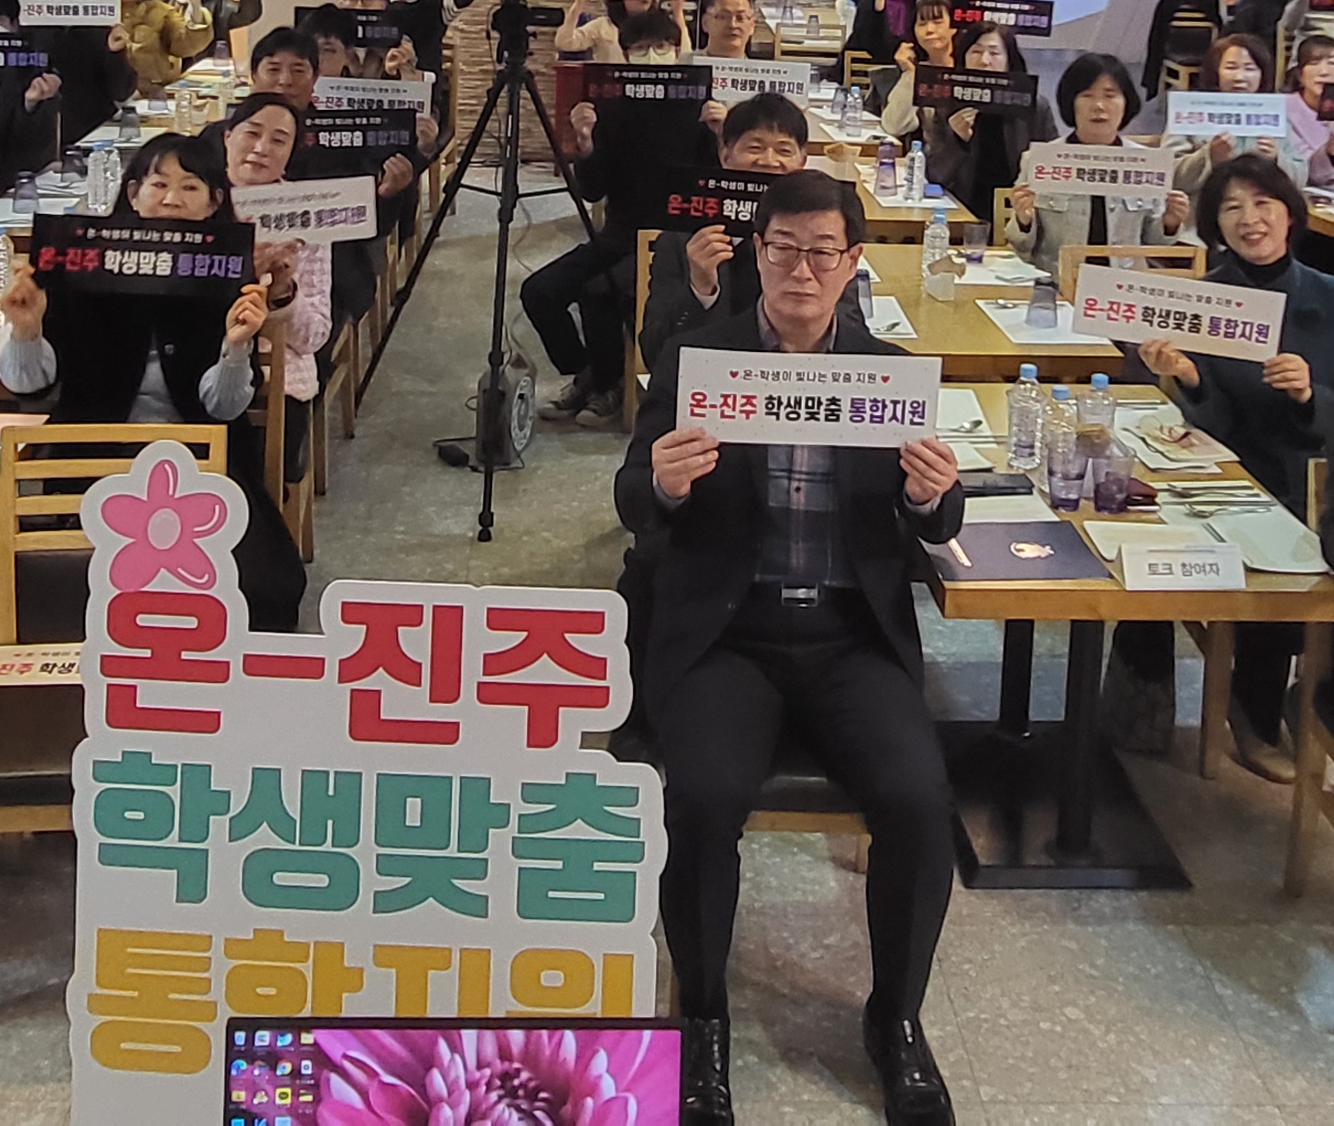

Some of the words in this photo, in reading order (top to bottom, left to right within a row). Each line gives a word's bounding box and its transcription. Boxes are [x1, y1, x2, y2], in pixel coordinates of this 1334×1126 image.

[23, 5, 43, 16] -진주
[712, 77, 727, 90] 진주
[1035, 165, 1072, 180] 온-진주
[1076, 167, 1119, 184] 학생맞춤
[1122, 169, 1166, 186] 통합지원
[668, 194, 719, 218] 온-진주
[722, 198, 758, 221] 학생
[39, 247, 99, 272] 온-진주
[104, 250, 173, 278] 학생맞춤
[177, 253, 243, 279] 통합지원
[1083, 297, 1136, 323] 온-진주
[1141, 306, 1203, 334] 학생맞춤
[1207, 316, 1270, 344] 통합지원
[743, 370, 790, 382] 온-학생이
[795, 370, 827, 382] 빛나는
[831, 371, 853, 384] 맞춤
[856, 372, 876, 384] 지원
[688, 392, 757, 419] 온-진주
[764, 394, 842, 422] 학생맞춤
[848, 397, 926, 425] 통합지원
[1147, 562, 1175, 576] 토크
[1180, 562, 1221, 577] 참여자
[39, 662, 80, 675] 학생
[98, 589, 611, 749] 온-진주
[91, 750, 647, 925] 학생맞춤
